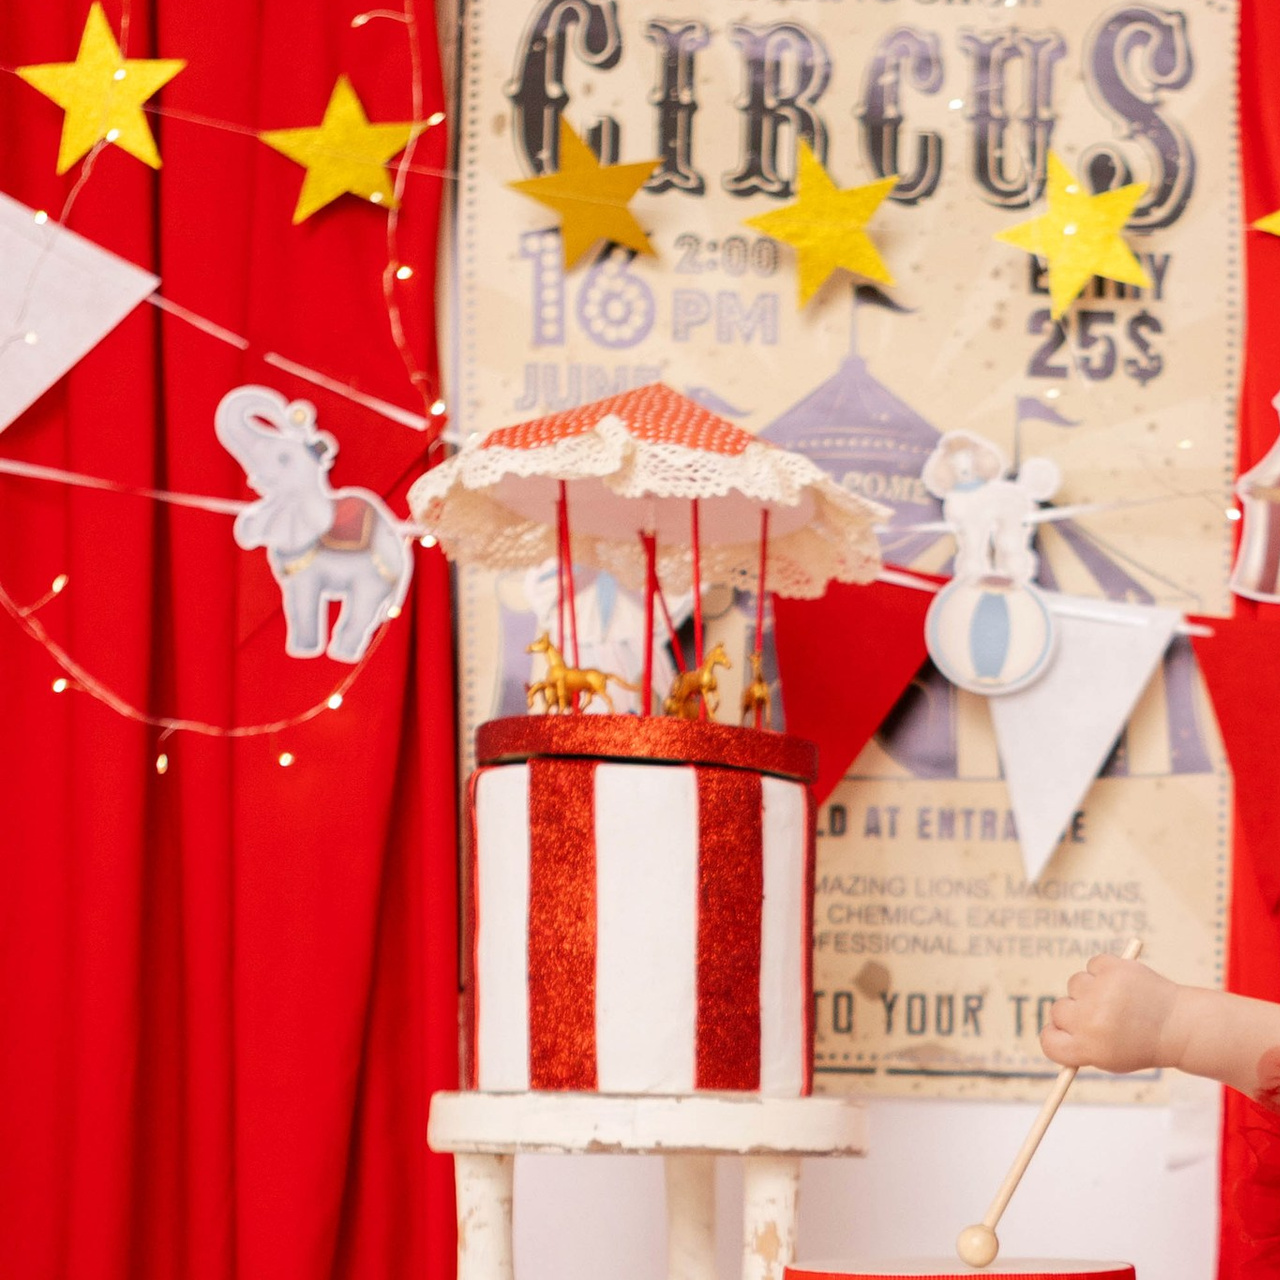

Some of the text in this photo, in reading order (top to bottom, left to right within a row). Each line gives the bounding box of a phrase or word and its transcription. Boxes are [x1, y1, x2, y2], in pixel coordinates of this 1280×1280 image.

[503, 0, 1196, 236] CIRCUS
[674, 233, 780, 278] 2:00
[519, 226, 656, 350] 16
[672, 290, 779, 346] PM
[1027, 310, 1164, 386] 25$
[842, 470, 930, 506] COME
[864, 805, 900, 838] AT
[917, 806, 1086, 843] ENTRAE
[815, 874, 906, 897] MAZING
[827, 903, 960, 926] CHEMICAL
[814, 931, 1150, 960] FESSIONAL ENTERTAINE
[880, 992, 983, 1037] YOUR
